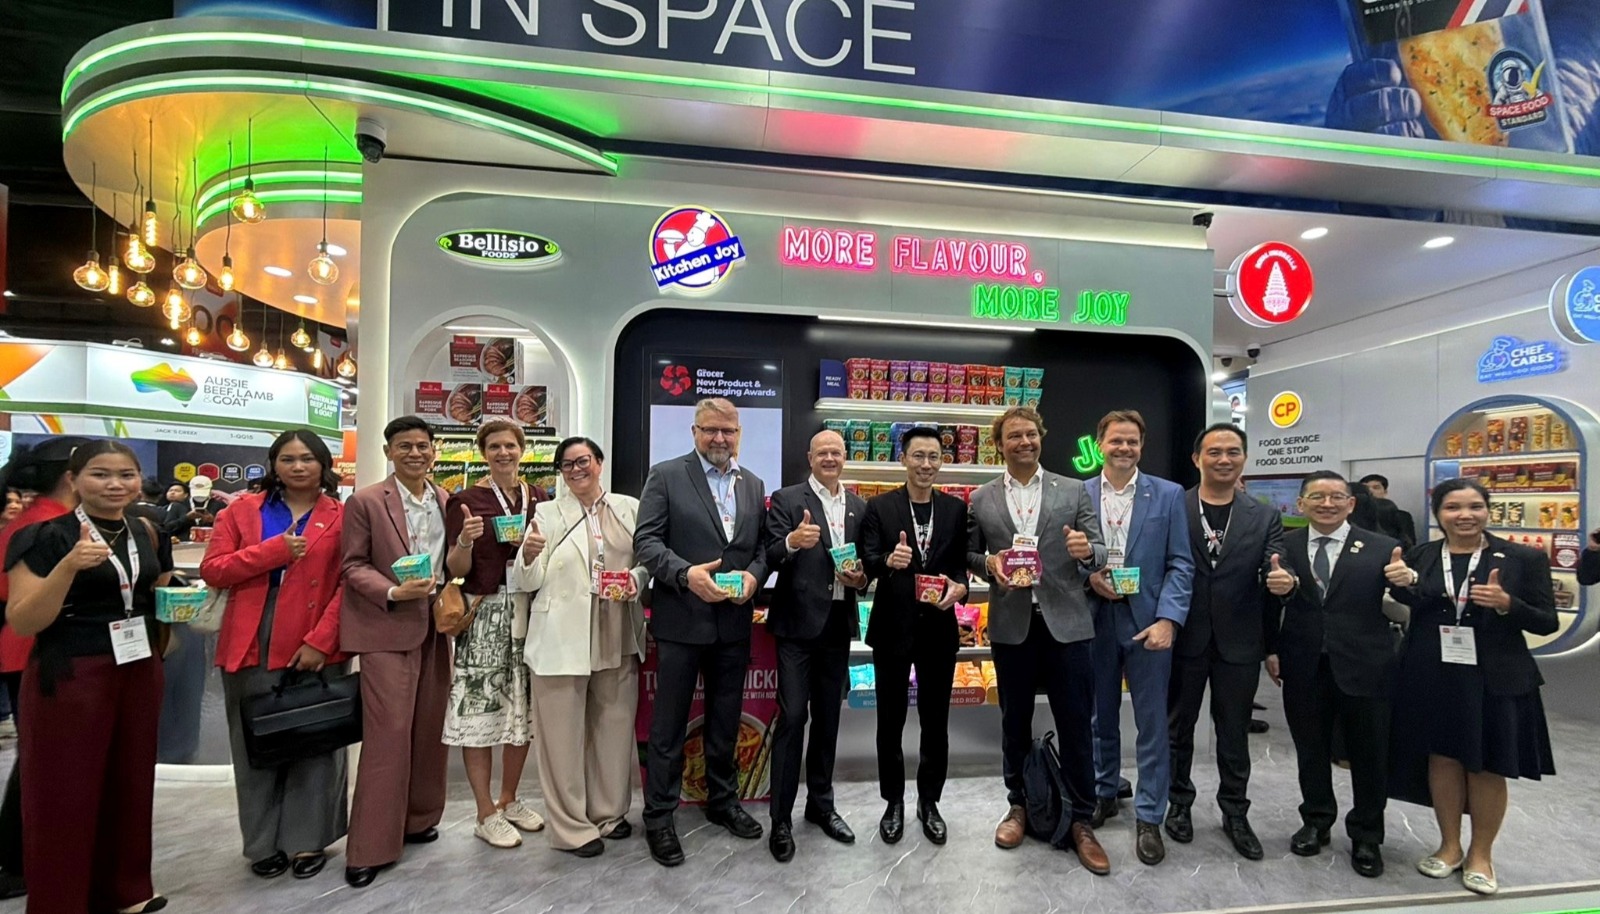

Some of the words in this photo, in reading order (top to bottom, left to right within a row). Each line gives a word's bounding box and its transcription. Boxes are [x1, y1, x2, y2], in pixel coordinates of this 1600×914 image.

[582, 0, 916, 76] SPACE
[1489, 105, 1521, 117] SPACE
[1521, 96, 1549, 112] FOOD
[1501, 110, 1545, 126] STANDARD
[457, 233, 539, 254] Bellisio
[783, 226, 876, 267] MORE
[653, 252, 712, 282] Kitchen
[713, 242, 740, 261] Joy
[973, 283, 1060, 321] MORE
[1072, 290, 1132, 327] JOY
[1510, 344, 1545, 358] CHEF
[1510, 352, 1554, 367] CARES
[204, 376, 249, 389] AUSSIE
[696, 379, 716, 387] New
[718, 380, 753, 388] Product
[754, 380, 761, 388] &
[696, 387, 742, 397] Packaging
[744, 389, 776, 397] Awards
[1274, 402, 1297, 418] CP
[1258, 438, 1282, 447] FOOD
[1283, 434, 1320, 445] SERVICE
[1267, 447, 1284, 456] ONE
[1286, 445, 1310, 455] STOP
[1255, 458, 1278, 466] FOOD
[1279, 455, 1323, 465] SOLUTION
